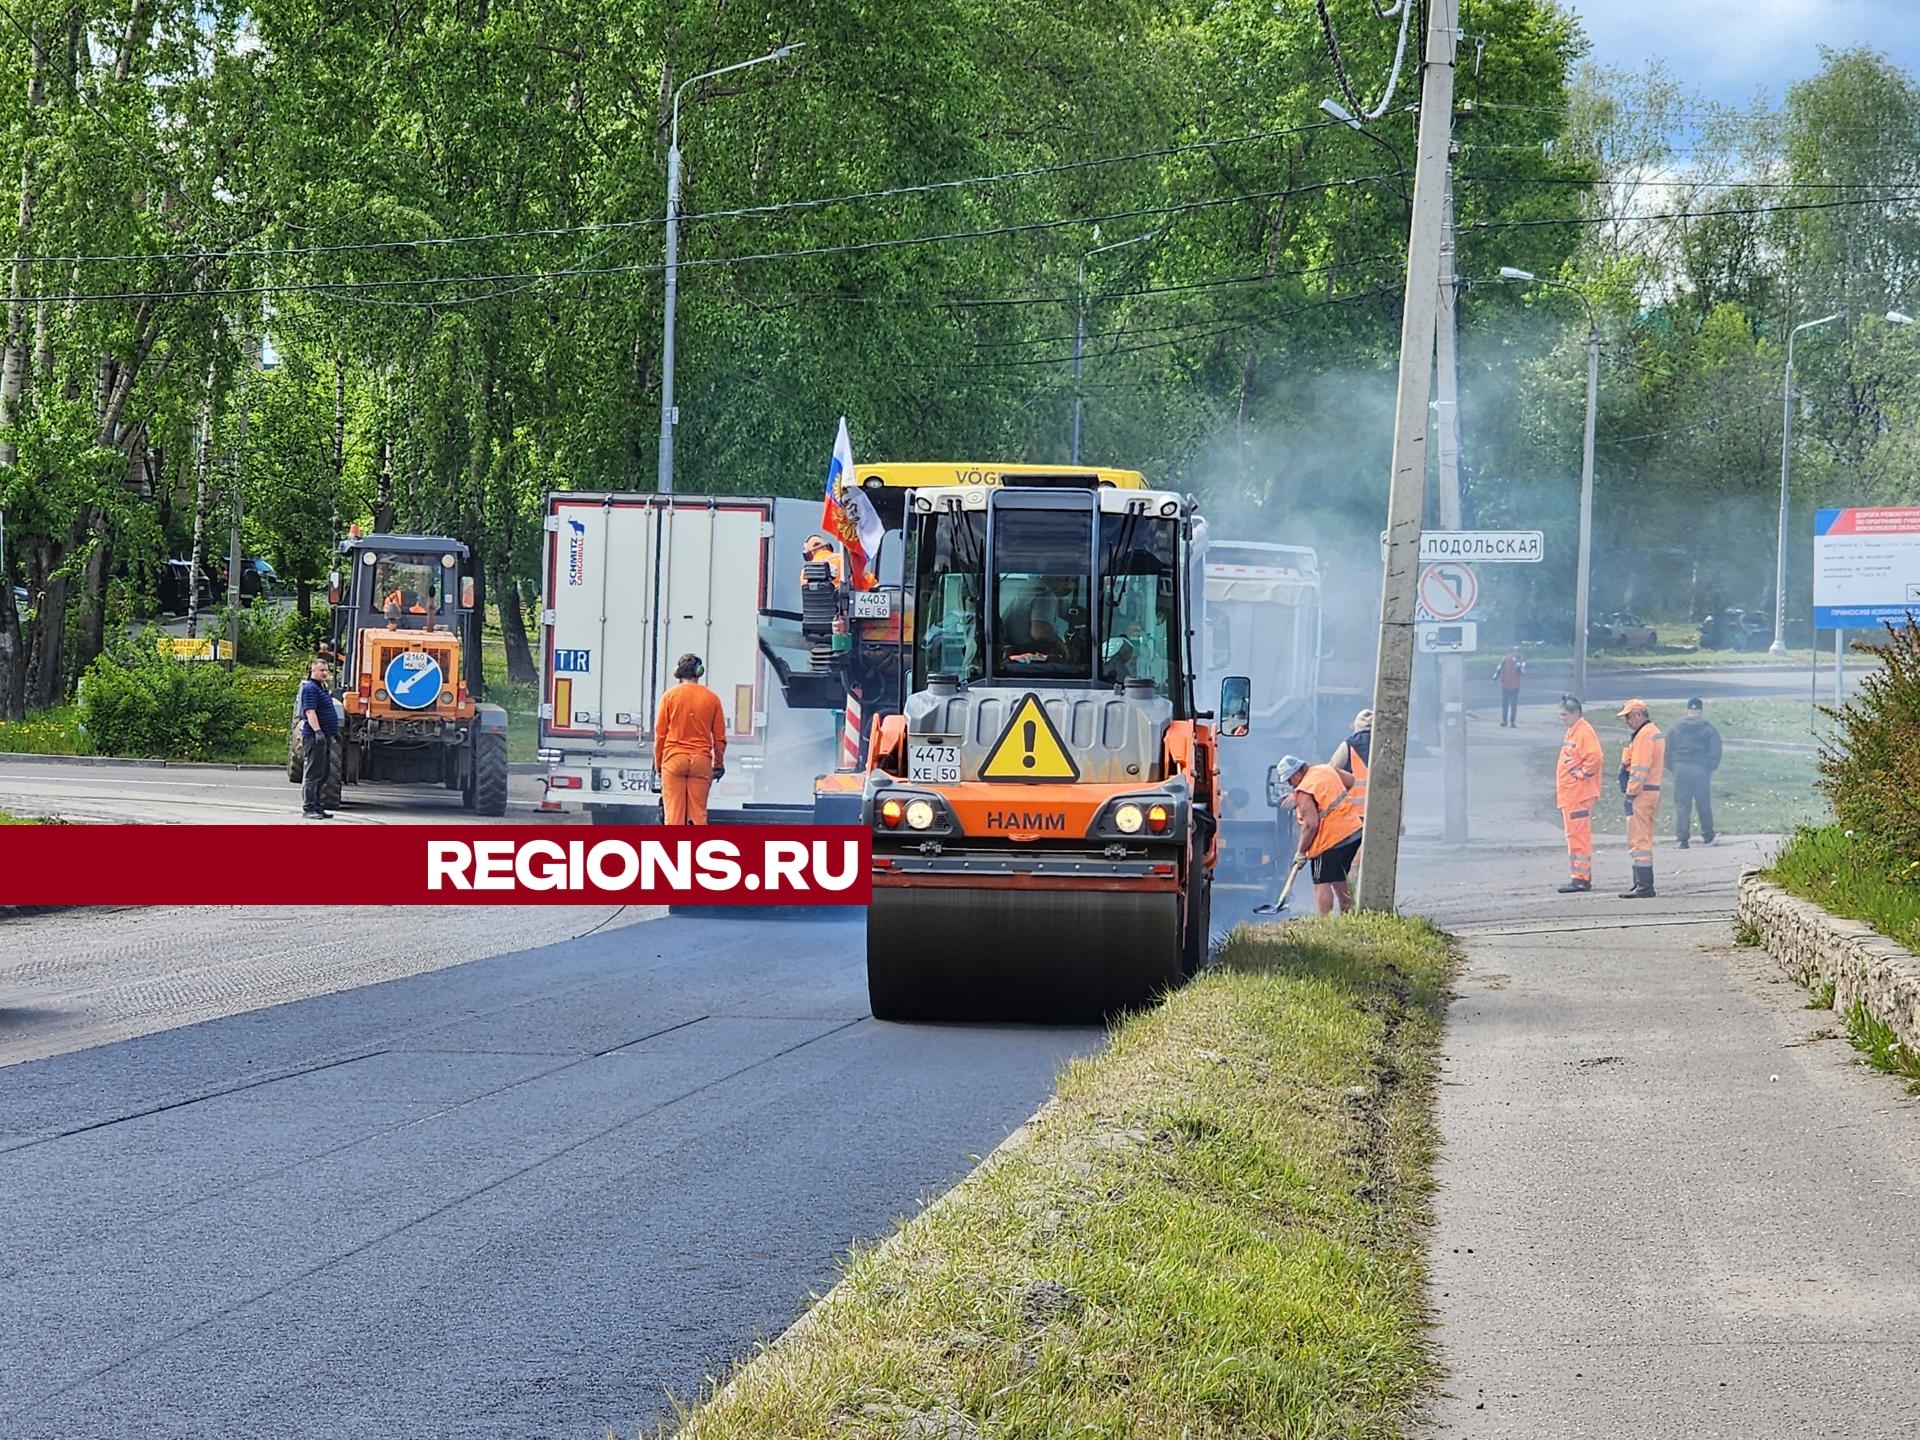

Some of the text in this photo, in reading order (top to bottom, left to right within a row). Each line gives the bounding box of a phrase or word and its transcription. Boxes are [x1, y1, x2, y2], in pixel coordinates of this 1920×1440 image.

[1419, 539, 1538, 555] .ПОДОЛЬСКАЯ
[569, 538, 577, 586] SCHMITZ
[859, 594, 886, 605] 4403
[876, 607, 888, 616] 50
[557, 651, 587, 670] TIR
[915, 747, 955, 762] 4473
[941, 768, 957, 780] 50
[987, 811, 1066, 831] HAMM
